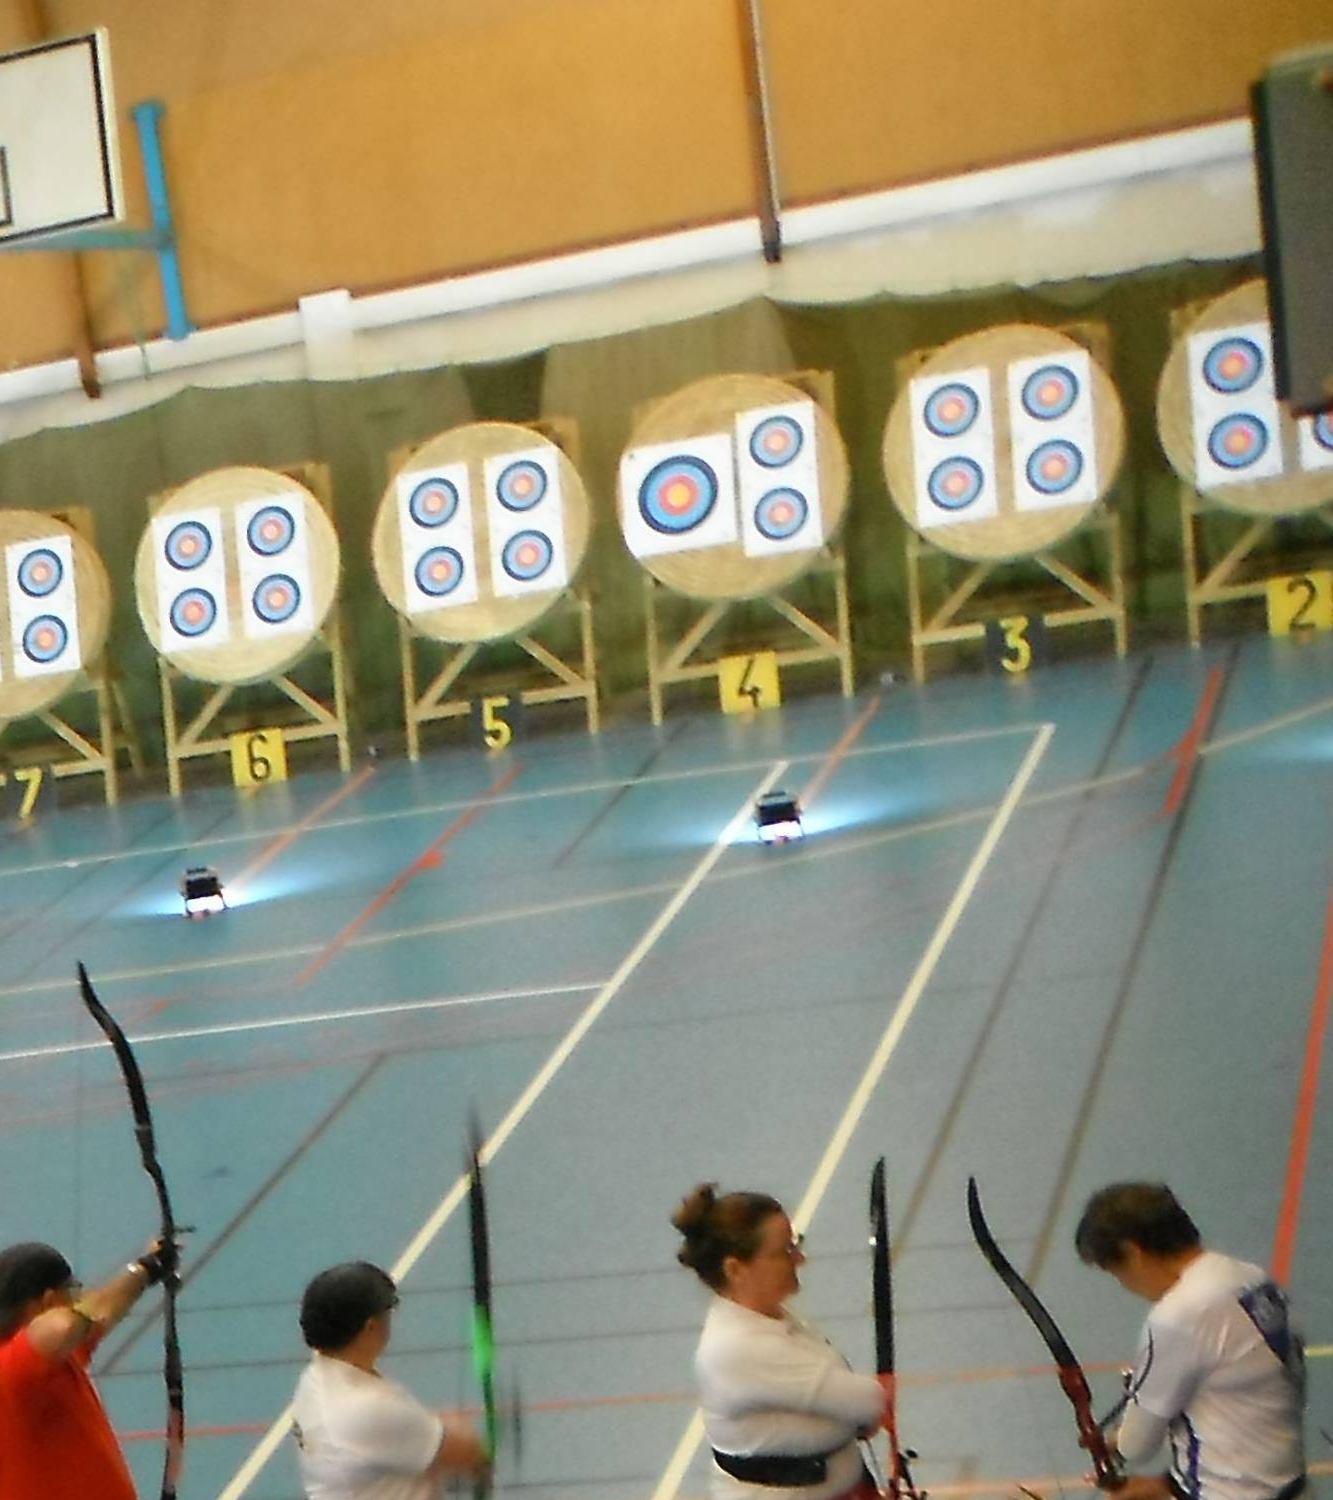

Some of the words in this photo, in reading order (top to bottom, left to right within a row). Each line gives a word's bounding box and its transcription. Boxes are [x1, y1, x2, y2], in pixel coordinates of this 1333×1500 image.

[1287, 578, 1317, 631] 2
[999, 616, 1031, 672] 3
[737, 658, 760, 708] 4
[482, 696, 512, 749] 5
[247, 733, 271, 782] 6
[14, 767, 43, 819] 7
